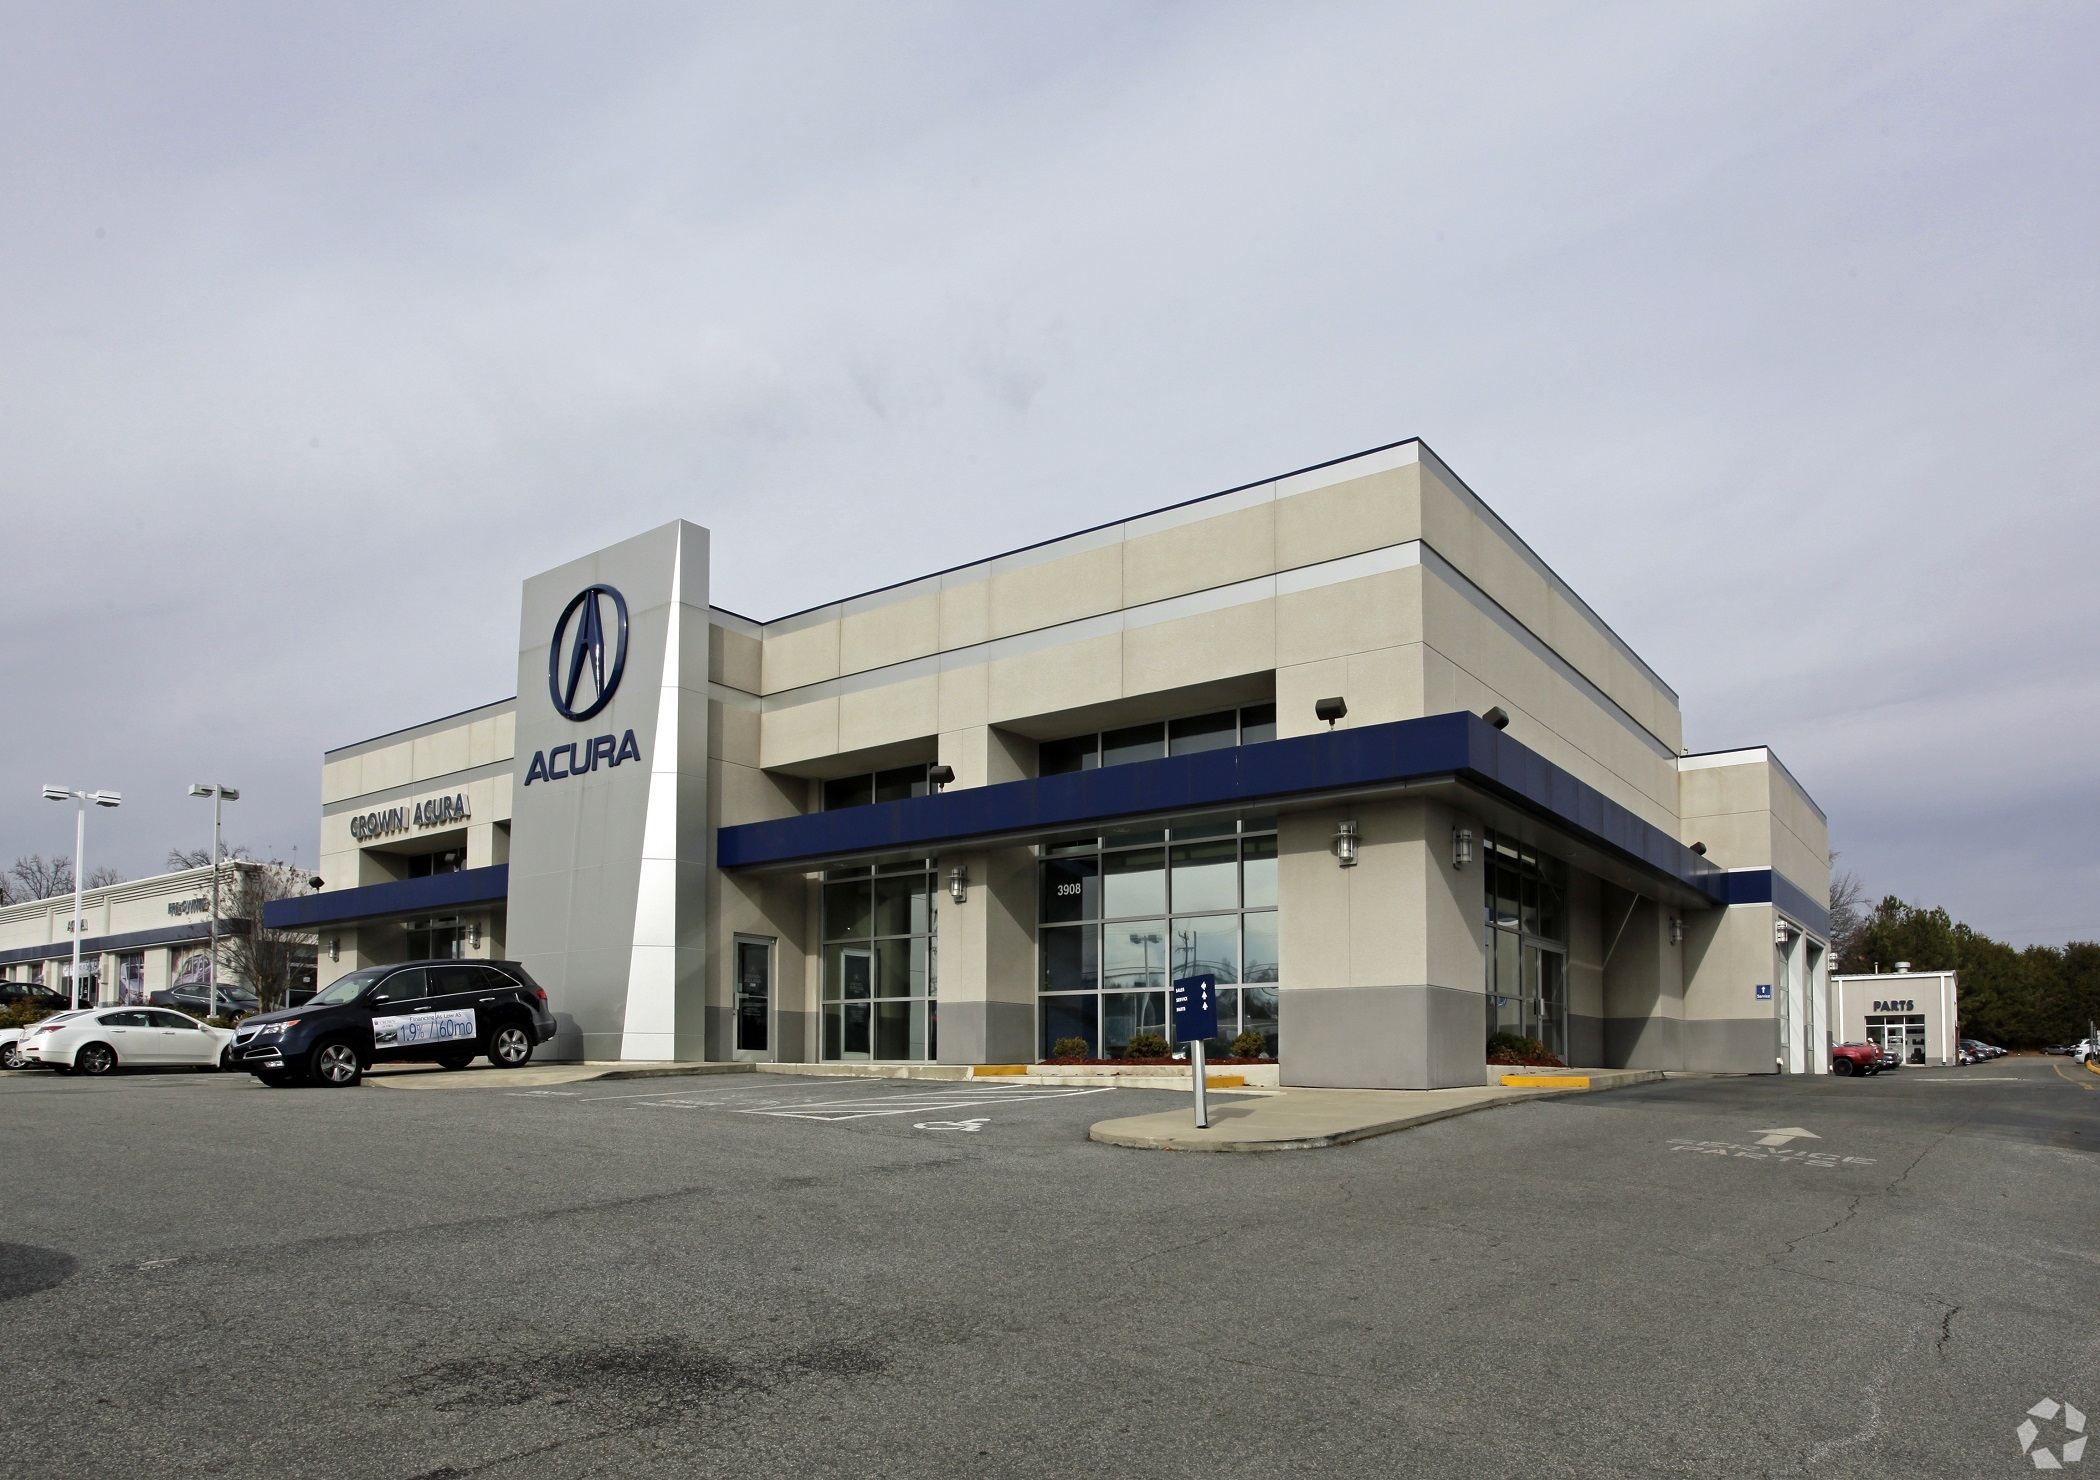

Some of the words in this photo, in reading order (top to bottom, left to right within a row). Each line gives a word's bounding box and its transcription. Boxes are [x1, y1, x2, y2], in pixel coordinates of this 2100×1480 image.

[524, 729, 641, 786] ACURA
[350, 806, 410, 840] CROWN
[413, 793, 471, 825] ACURA
[1057, 883, 1081, 896] 3908
[1873, 1000, 1914, 1012] PARTS
[400, 1023, 425, 1042] 1.9%
[439, 1019, 474, 1038] 60mo
[1666, 1138, 1878, 1165] SERVICE
[1670, 1145, 1838, 1168] PARTS
